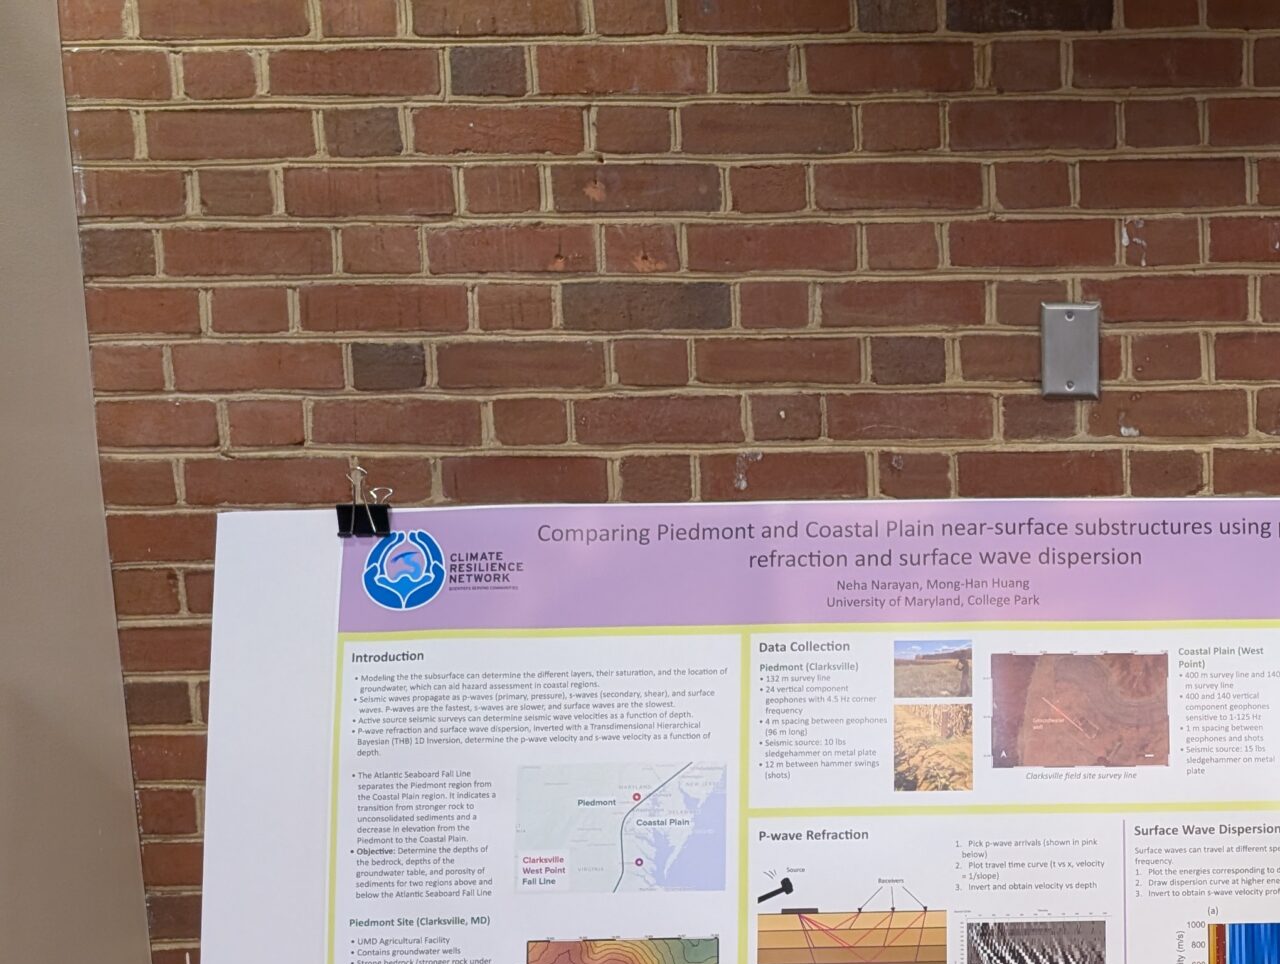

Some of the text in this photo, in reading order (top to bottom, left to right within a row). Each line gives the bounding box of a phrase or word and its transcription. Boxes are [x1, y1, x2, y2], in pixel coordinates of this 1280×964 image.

[538, 524, 650, 546] Comparing
[658, 522, 755, 541] Piedmont
[761, 520, 798, 539] and
[806, 520, 878, 538] Coastal
[886, 519, 934, 538] Plain
[942, 517, 1068, 536] near-surface
[1074, 517, 1213, 536] substructures
[1219, 517, 1272, 539] using
[450, 551, 503, 562] CLIMATE
[749, 546, 1142, 569] refraction and surface wave dispersion
[449, 562, 524, 573] RESILIENCE
[449, 573, 510, 584] NETWORK
[837, 576, 1030, 592] Neha Narayan, Mong-Han Huang
[827, 594, 1040, 609] University of Maryland, College Park
[759, 640, 850, 653] Data Collection
[1178, 646, 1264, 658] Coastal Plain (West
[352, 650, 424, 663] Introduction
[759, 661, 859, 674] Piedmont (Clarksville)
[1176, 659, 1206, 670] Point)
[766, 674, 780, 684] 132
[790, 675, 816, 683] survey
[817, 674, 831, 682] line
[577, 799, 616, 808] Piedmont
[669, 818, 690, 826] Plain
[758, 828, 869, 842] P-wave Refraction
[1134, 824, 1179, 836] Surface
[1182, 824, 1215, 835] Wave
[522, 856, 564, 864] Clarksville
[522, 866, 566, 875] West Point
[522, 877, 556, 886] Fall Line
[1148, 879, 1168, 887] Draw
[1169, 878, 1208, 887] dispersion
[1240, 876, 1265, 886] higher
[349, 915, 491, 928] Piedmont Site (Clarksville, MD)
[1187, 920, 1206, 929] 1000
[1176, 930, 1186, 952] (m/s)
[1191, 940, 1206, 949] 800
